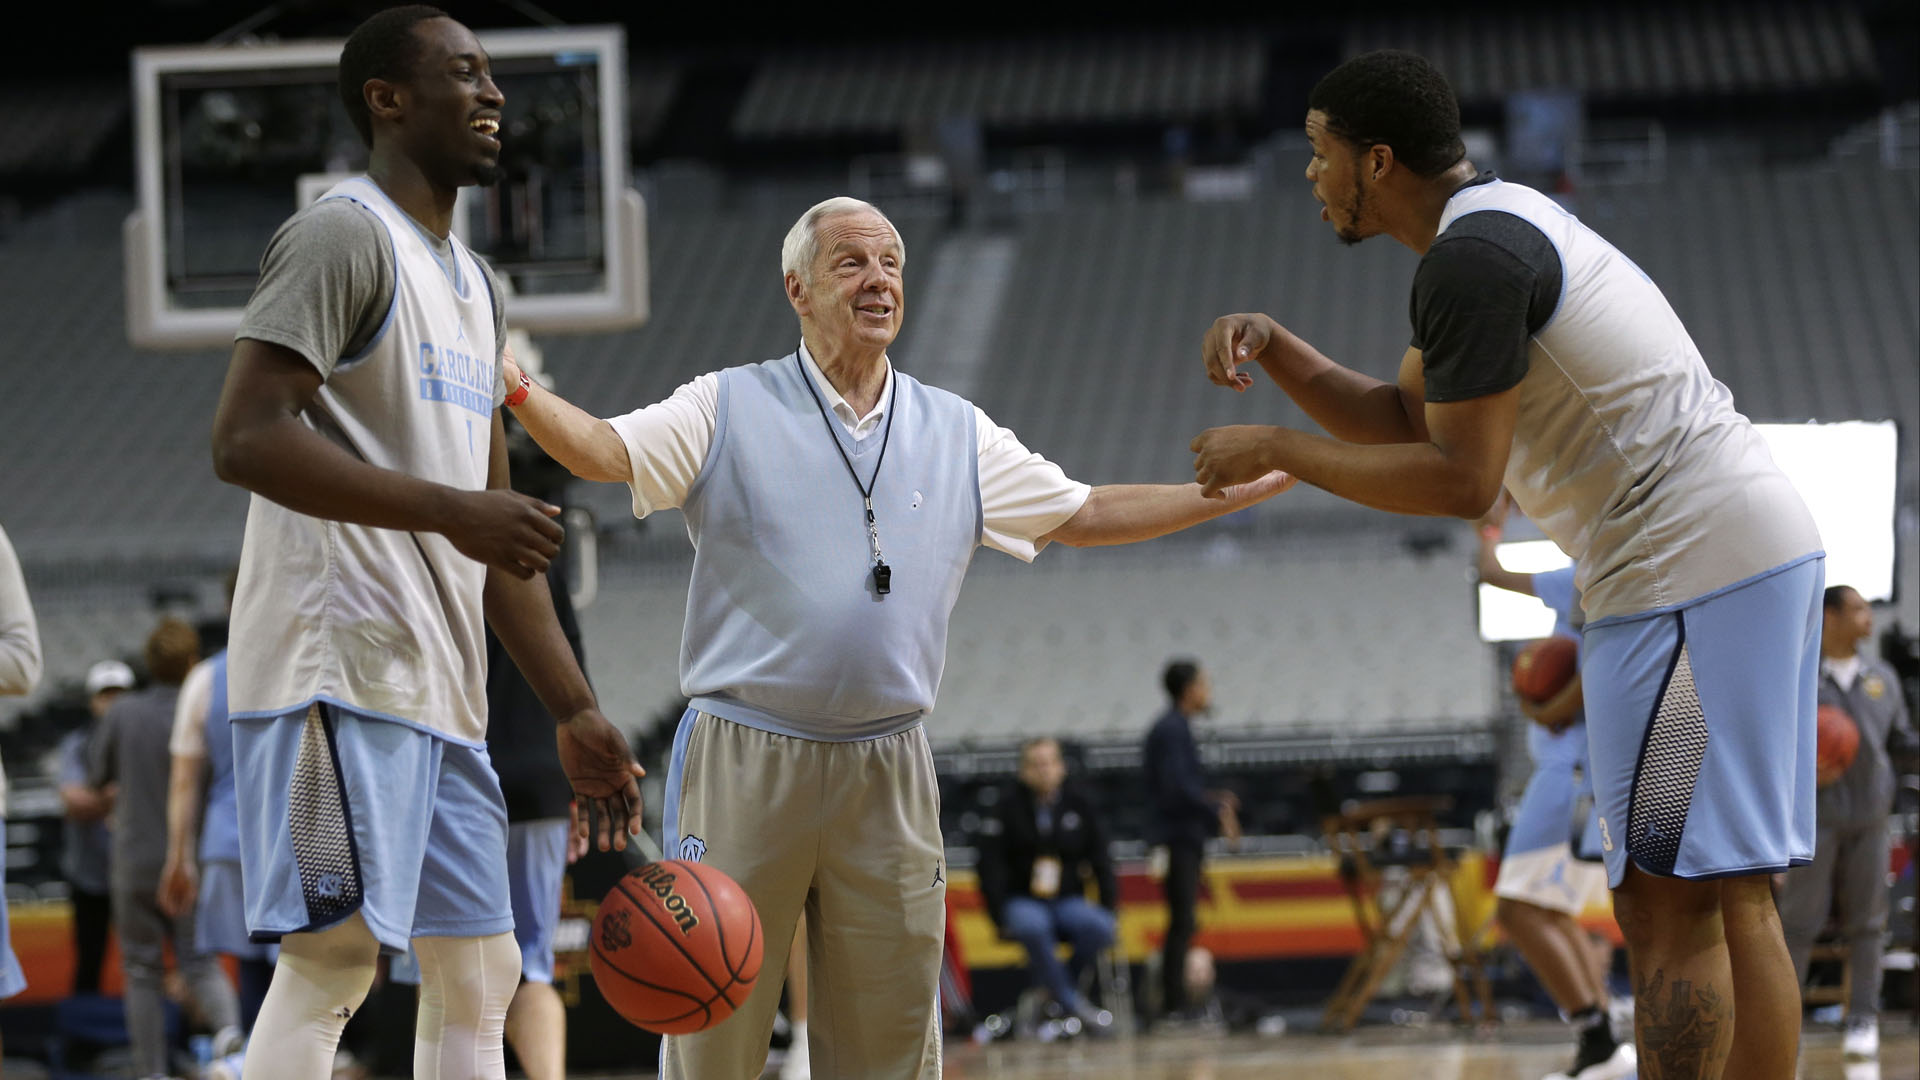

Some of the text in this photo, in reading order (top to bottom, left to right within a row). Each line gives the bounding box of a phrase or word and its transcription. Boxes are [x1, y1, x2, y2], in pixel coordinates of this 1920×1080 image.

[466, 420, 474, 457] 1
[1599, 816, 1614, 852] 3
[631, 863, 700, 936] Wilson
